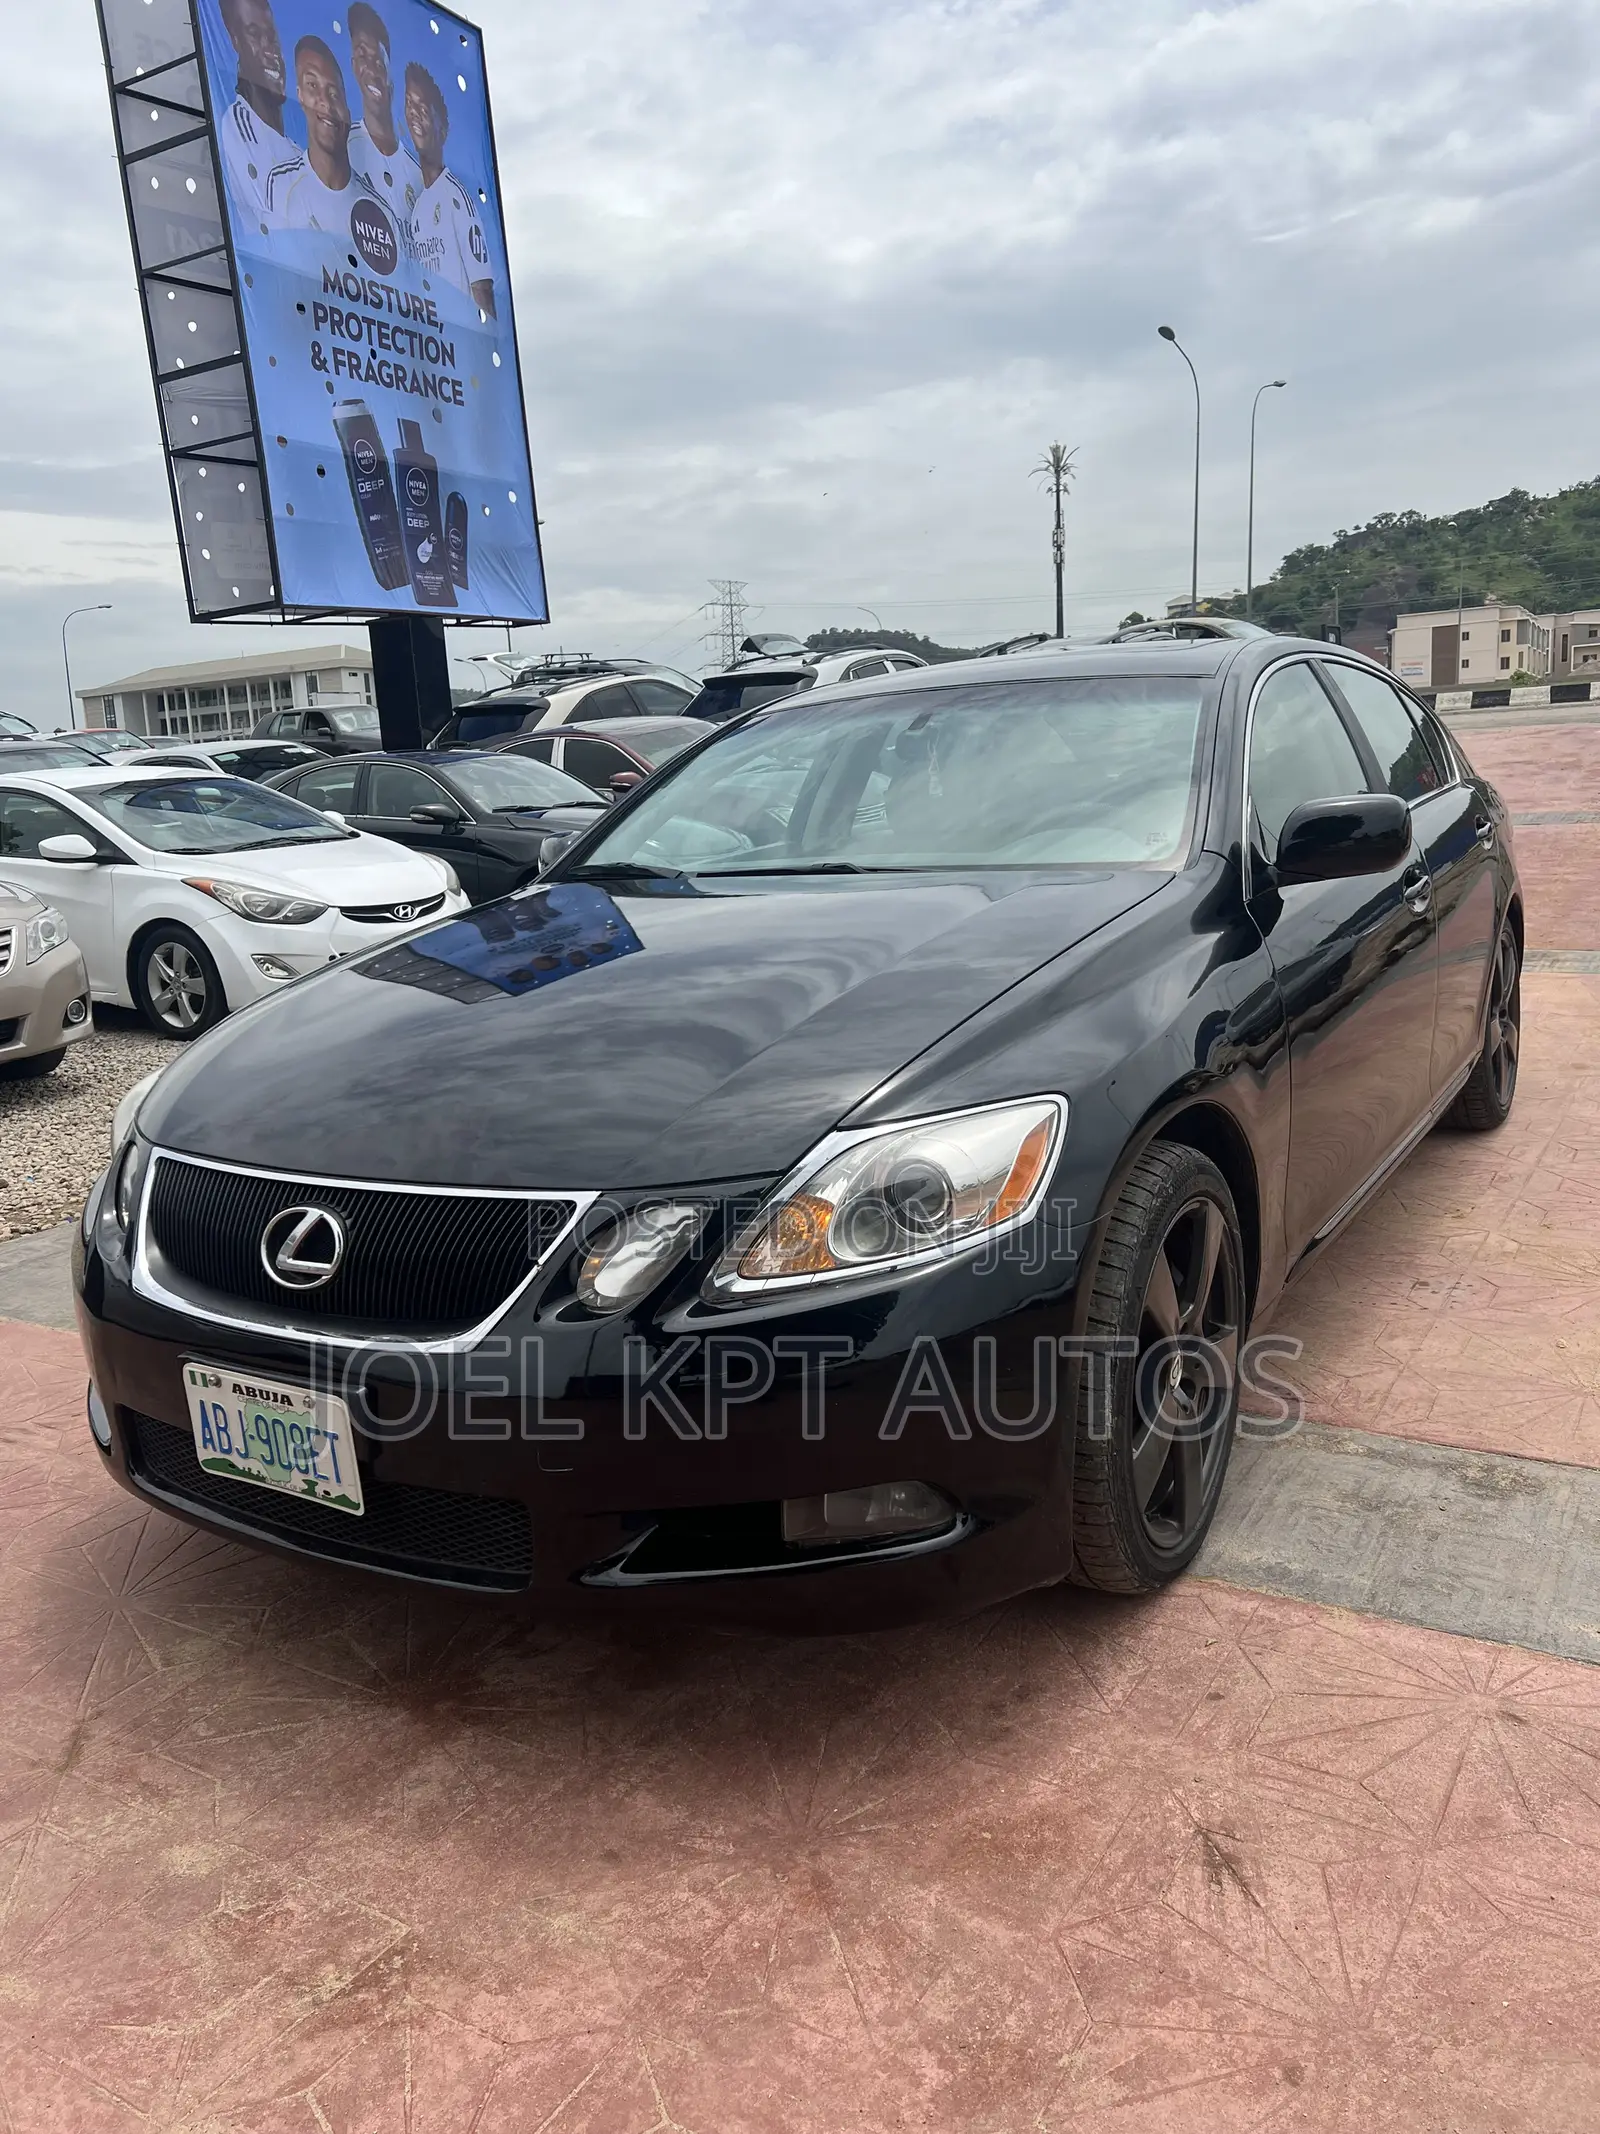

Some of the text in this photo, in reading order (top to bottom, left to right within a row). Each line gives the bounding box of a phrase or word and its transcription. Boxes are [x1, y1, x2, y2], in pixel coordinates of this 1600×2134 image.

[355, 220, 393, 247] NIVEA
[362, 239, 391, 260] MEN
[322, 264, 444, 334] MOISTURE,
[312, 301, 456, 370] PROTECTION
[310, 340, 465, 407] & FRAGRANCE
[357, 450, 374, 459] NIVEA
[358, 479, 385, 493] DEEP
[408, 480, 427, 490] NIVEA
[411, 488, 425, 496] MEN
[407, 518, 430, 529] DEEP
[232, 1382, 294, 1407] ABUJA
[199, 1400, 342, 1484] ABJ-908ET
